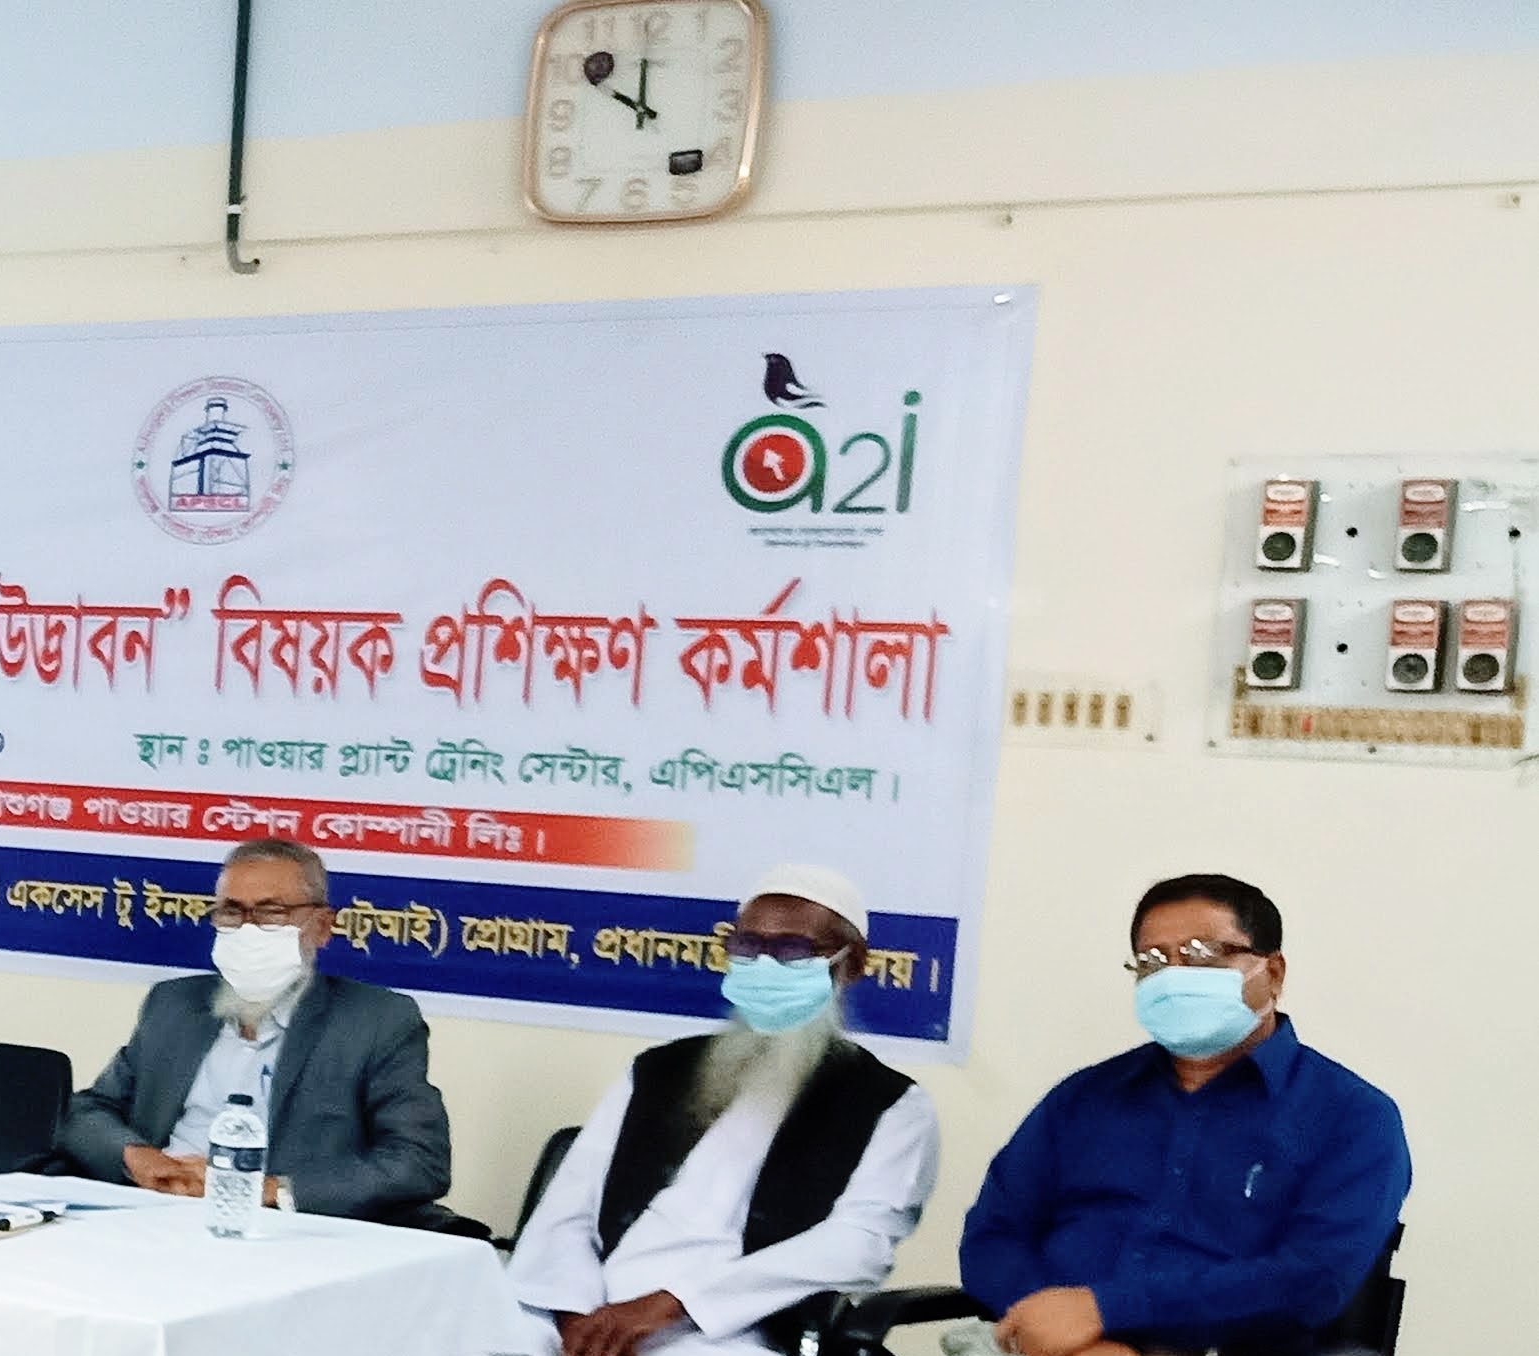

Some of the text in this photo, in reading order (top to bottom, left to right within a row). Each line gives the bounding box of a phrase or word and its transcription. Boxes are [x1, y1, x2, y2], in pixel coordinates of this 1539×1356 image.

[213, 574, 402, 700] বিষয়ক
[420, 579, 656, 710] প্রশিক্ষণ
[674, 577, 950, 724] কর্মশালা
[223, 739, 327, 772] পাওয়ার
[426, 740, 503, 785] ট্রেনিং
[519, 746, 632, 793] সেন্টার,
[650, 749, 877, 800] এপিএসসিএল
[83, 796, 190, 832] পাওয়ার
[202, 806, 301, 838] স্টেশন
[312, 812, 453, 850] কোম্পানী
[6, 882, 105, 915] একসেস
[114, 885, 135, 929] টু
[461, 915, 581, 966] প্রোগ্রাম,
